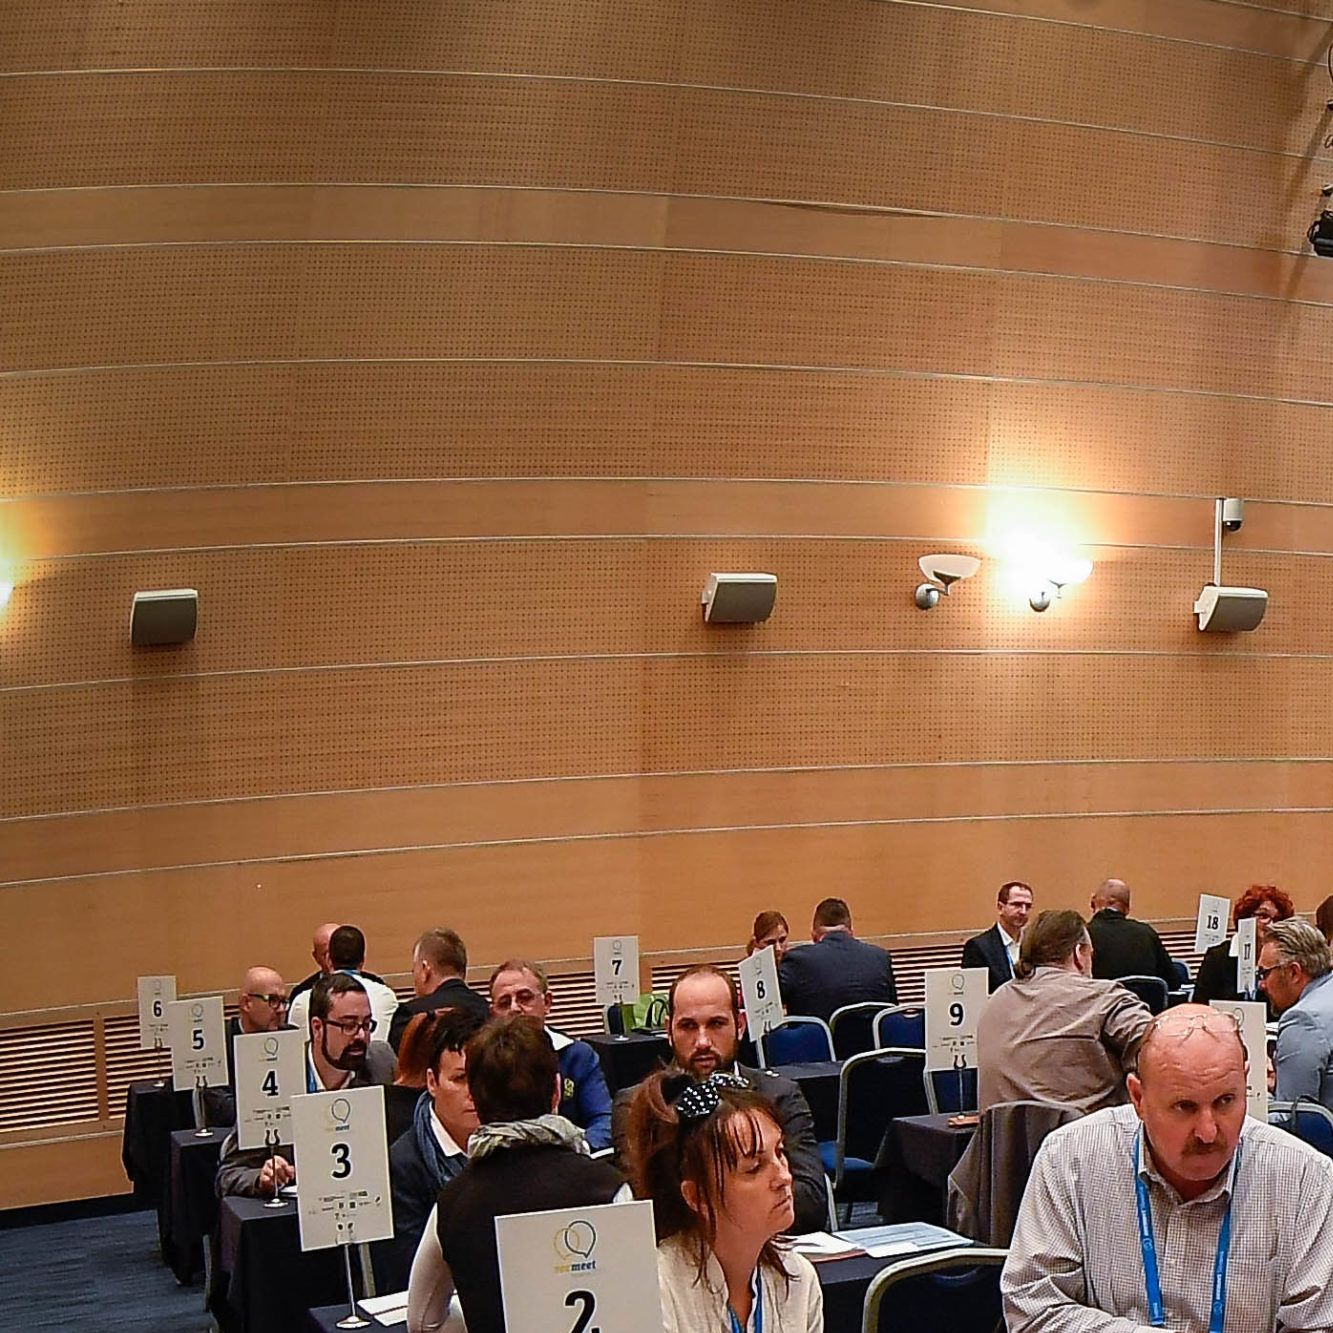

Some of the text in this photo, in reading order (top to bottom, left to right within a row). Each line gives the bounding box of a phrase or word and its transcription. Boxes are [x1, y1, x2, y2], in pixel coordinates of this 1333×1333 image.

[1206, 915, 1219, 930] 18
[611, 959, 622, 976] 7
[756, 980, 766, 999] 8
[153, 1000, 162, 1018] 6
[949, 1002, 964, 1026] 9
[192, 1029, 205, 1050] 5
[261, 1070, 279, 1097] 4
[331, 1143, 351, 1179] 3
